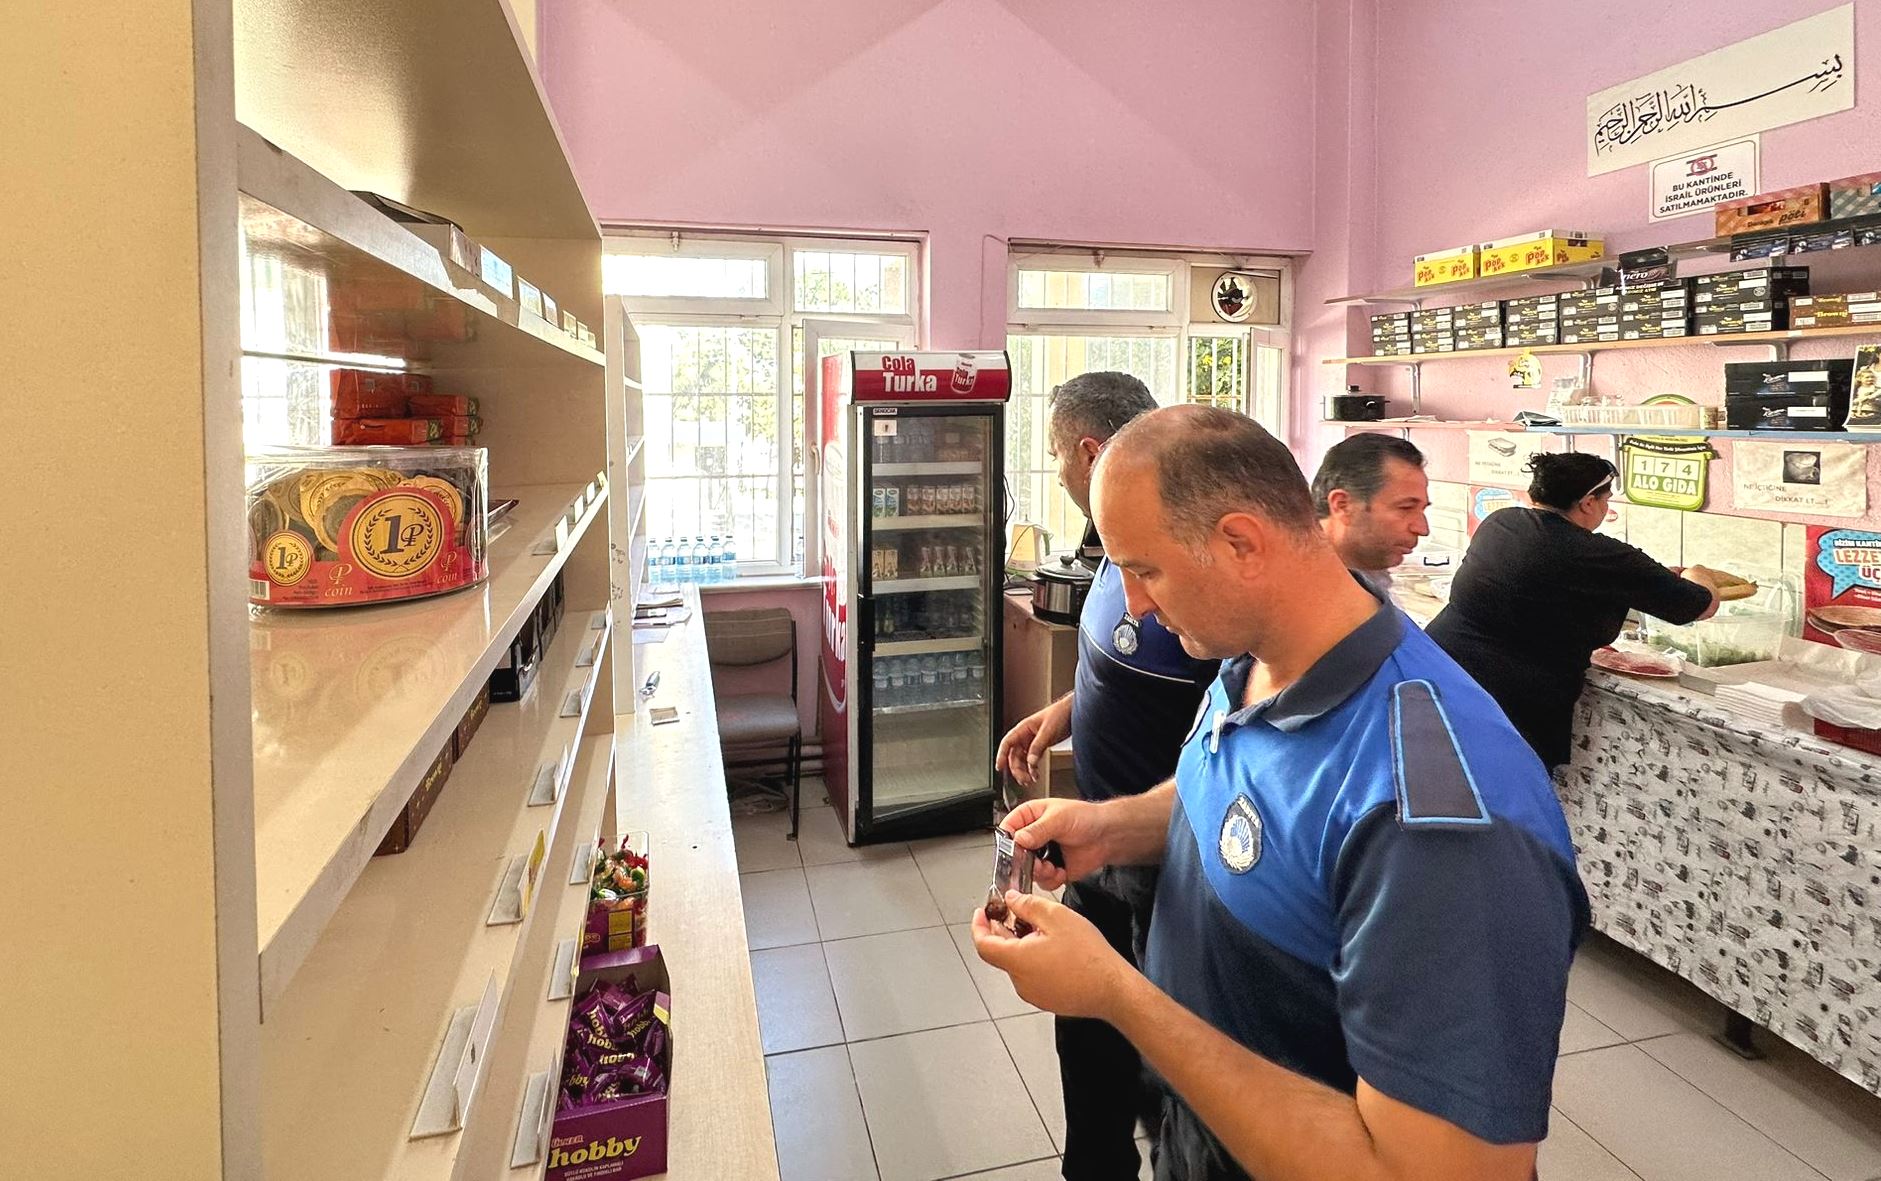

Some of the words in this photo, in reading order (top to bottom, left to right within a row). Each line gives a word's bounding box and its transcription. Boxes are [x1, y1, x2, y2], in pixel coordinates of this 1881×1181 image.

[1665, 191, 1693, 203] İSRAİL
[1694, 178, 1742, 197] ÜRÜNLERİ
[1672, 183, 1685, 192] BU
[1686, 171, 1733, 188] KANTİNDE
[1659, 189, 1748, 213] SATILMAMAKTADIR.
[882, 355, 914, 371] Cola
[883, 368, 938, 392] Turka
[1642, 460, 1648, 471] 1
[1660, 462, 1670, 473] 7
[1682, 464, 1692, 475] 4
[1633, 474, 1659, 490] ALO
[1662, 478, 1697, 495] GIDA
[380, 514, 405, 554] 1
[276, 546, 287, 570] 1
[1835, 549, 1881, 563] LEZZE
[436, 571, 458, 585] coin
[324, 583, 353, 598] coin
[548, 1136, 642, 1169] hobby
